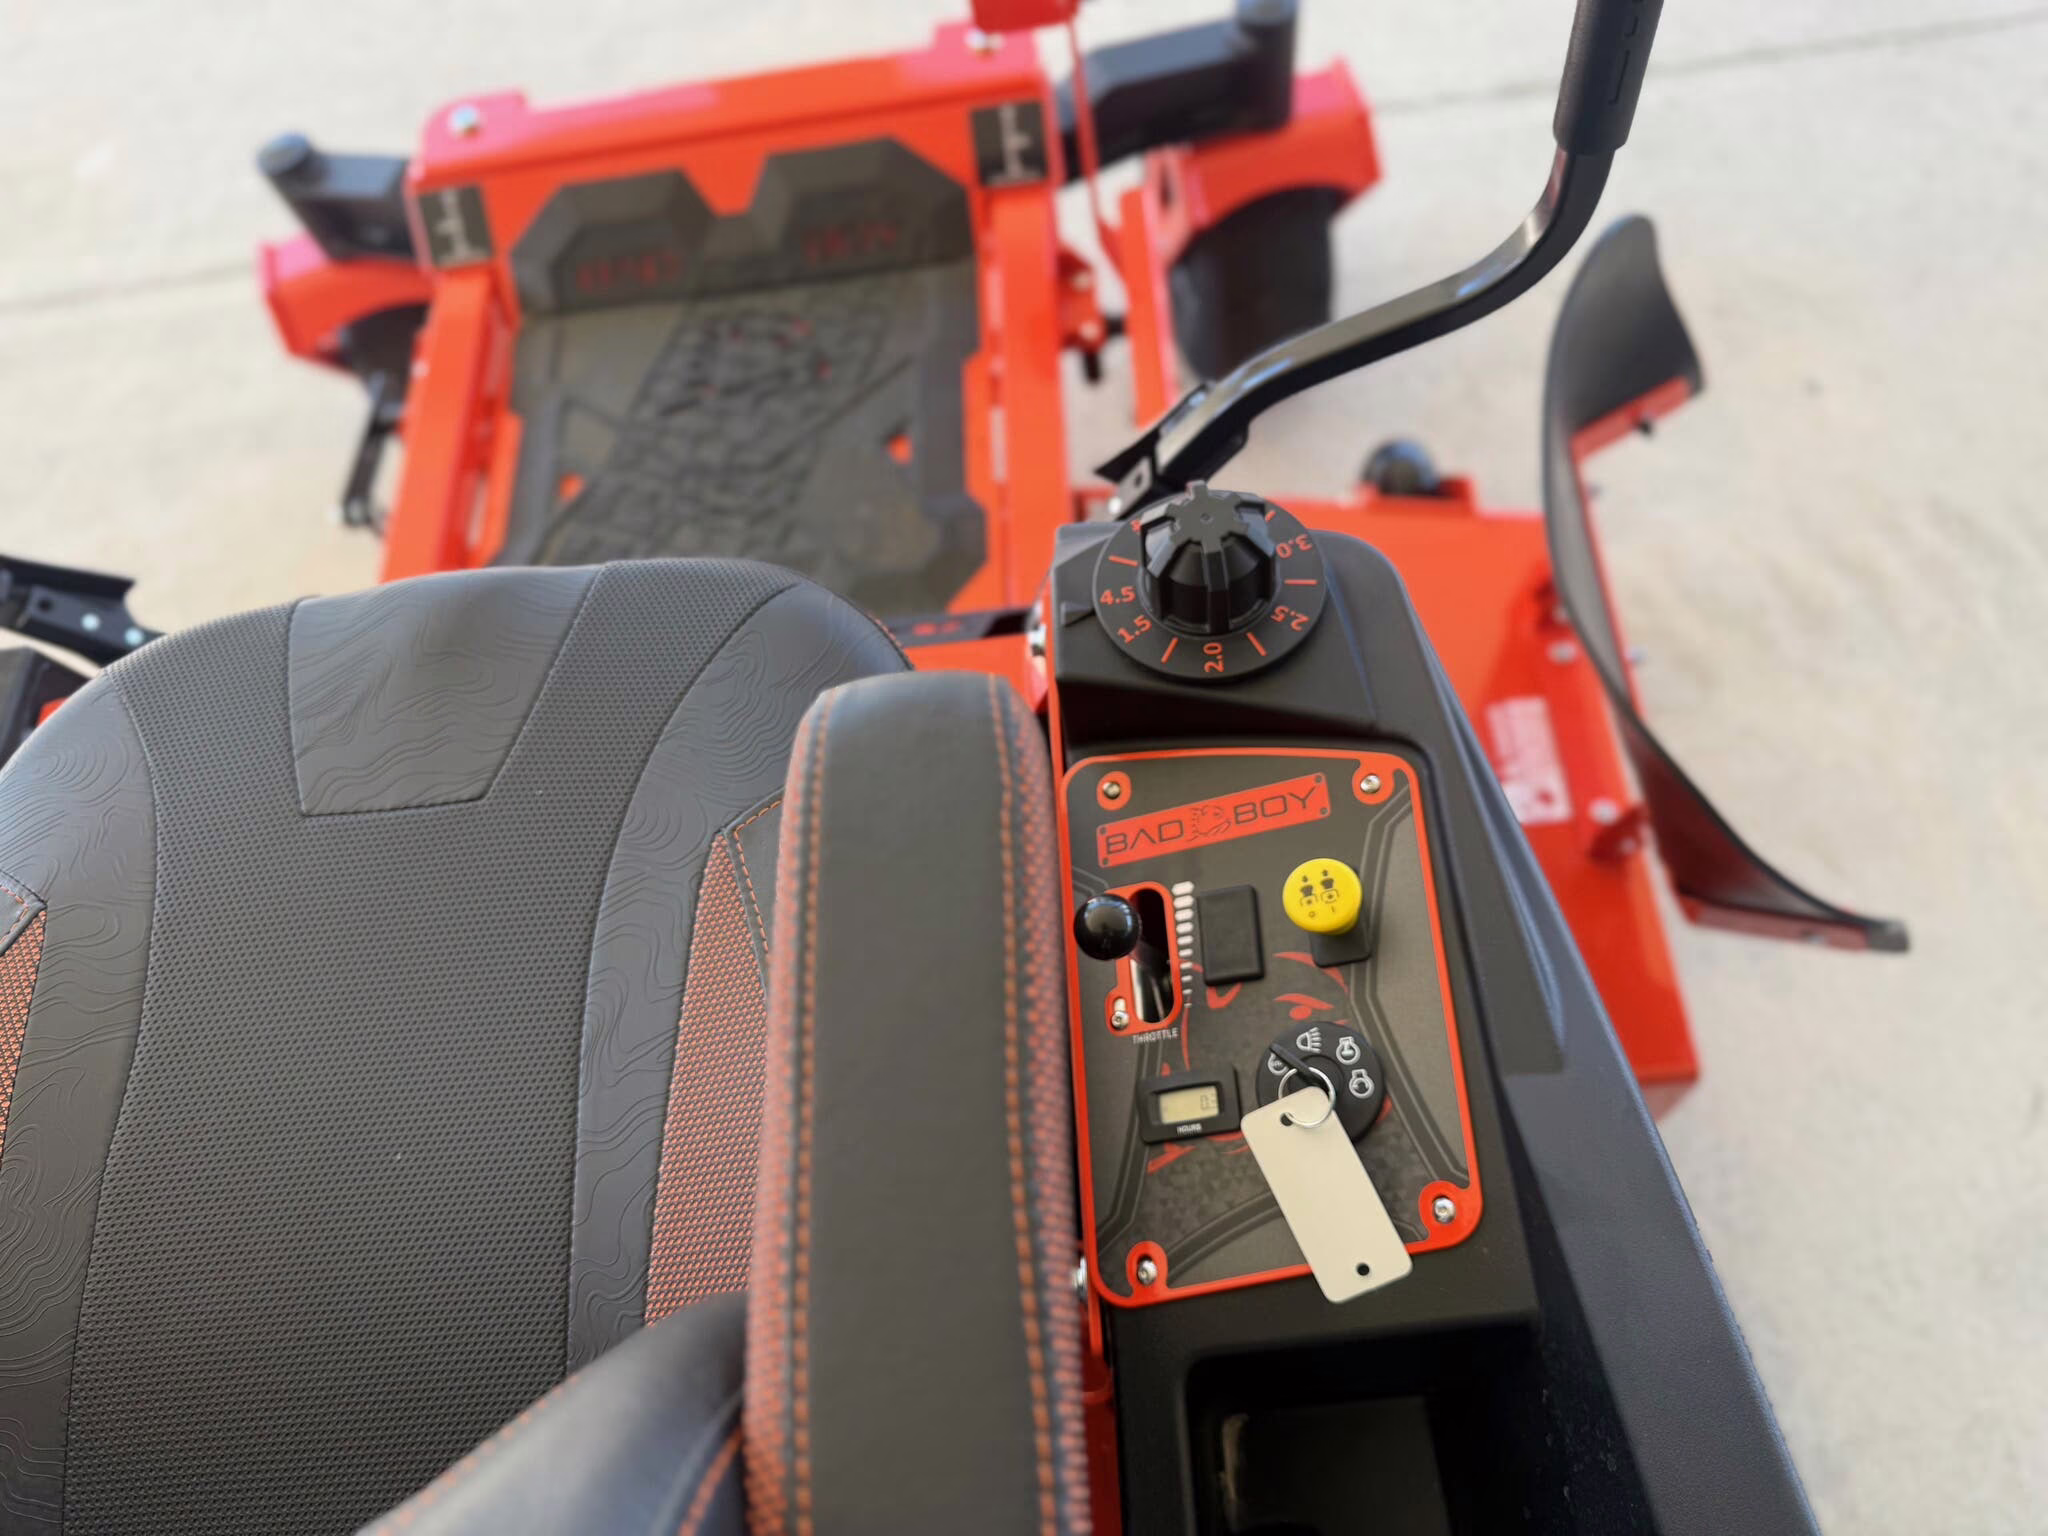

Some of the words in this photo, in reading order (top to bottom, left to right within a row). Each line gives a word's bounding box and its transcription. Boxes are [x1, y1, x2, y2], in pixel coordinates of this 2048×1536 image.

[1275, 533, 1312, 558] 3.0
[1100, 586, 1136, 605] 4.5
[1117, 615, 1152, 644] 1.5
[1272, 605, 1310, 631] 2.5
[1203, 642, 1224, 673] 2.0
[1106, 819, 1183, 855] BAD
[1234, 786, 1316, 824] BOY
[1132, 1028, 1179, 1045] THROTTLE
